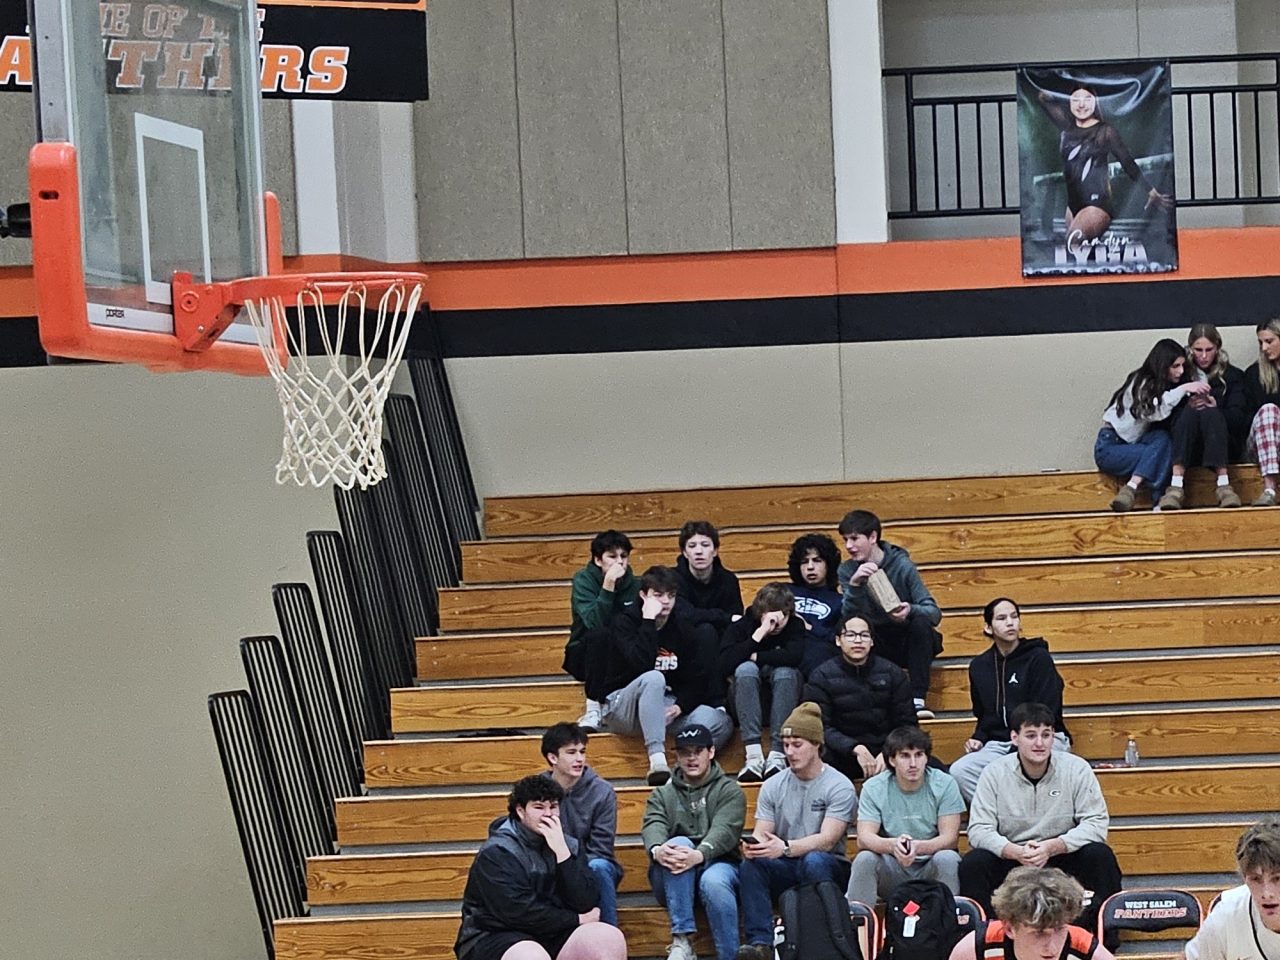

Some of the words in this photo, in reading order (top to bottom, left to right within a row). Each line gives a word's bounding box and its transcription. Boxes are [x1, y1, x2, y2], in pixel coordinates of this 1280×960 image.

[1067, 229, 1132, 254] Camdyn
[1125, 901, 1148, 909] WEST
[1149, 900, 1177, 909] SALEM
[1113, 907, 1188, 919] PANTHERS
